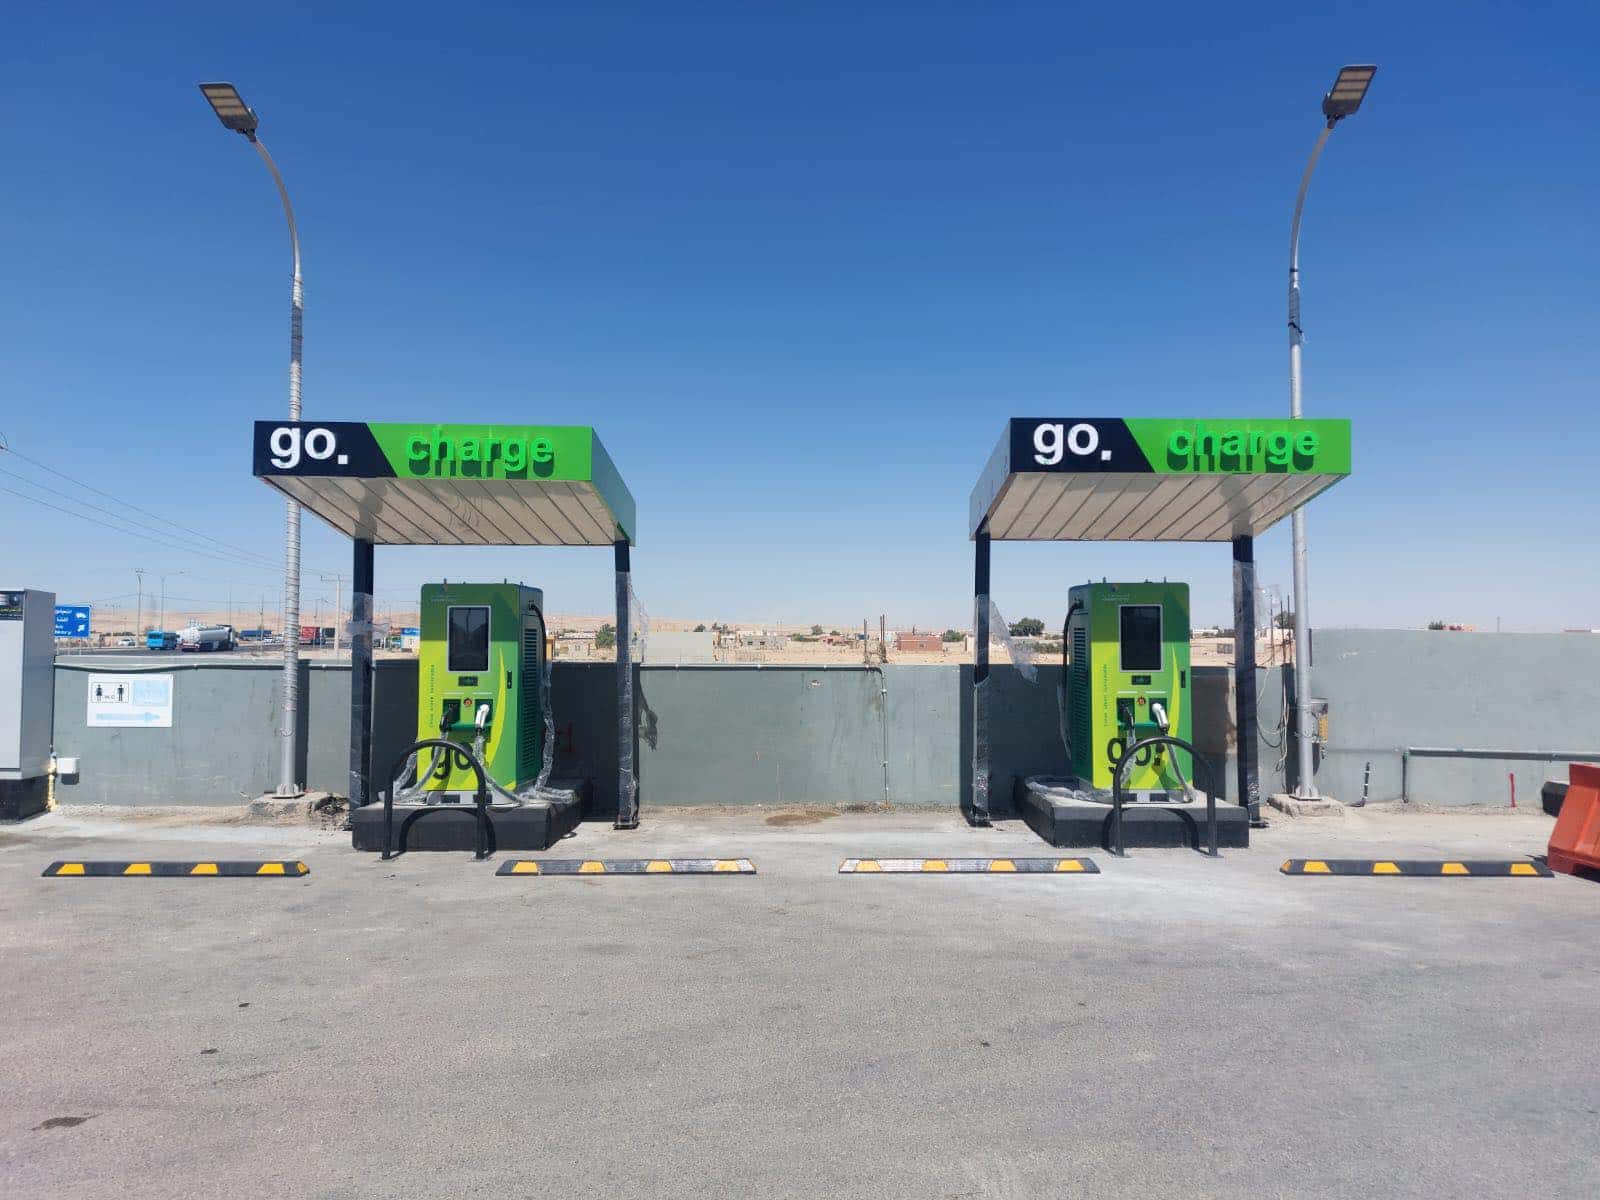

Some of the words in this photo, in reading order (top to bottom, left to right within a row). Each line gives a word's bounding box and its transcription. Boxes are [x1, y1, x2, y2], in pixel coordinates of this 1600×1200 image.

[270, 426, 348, 469] go.
[406, 426, 554, 471] charge
[1034, 422, 1112, 465] go.
[1168, 422, 1320, 465] charge
